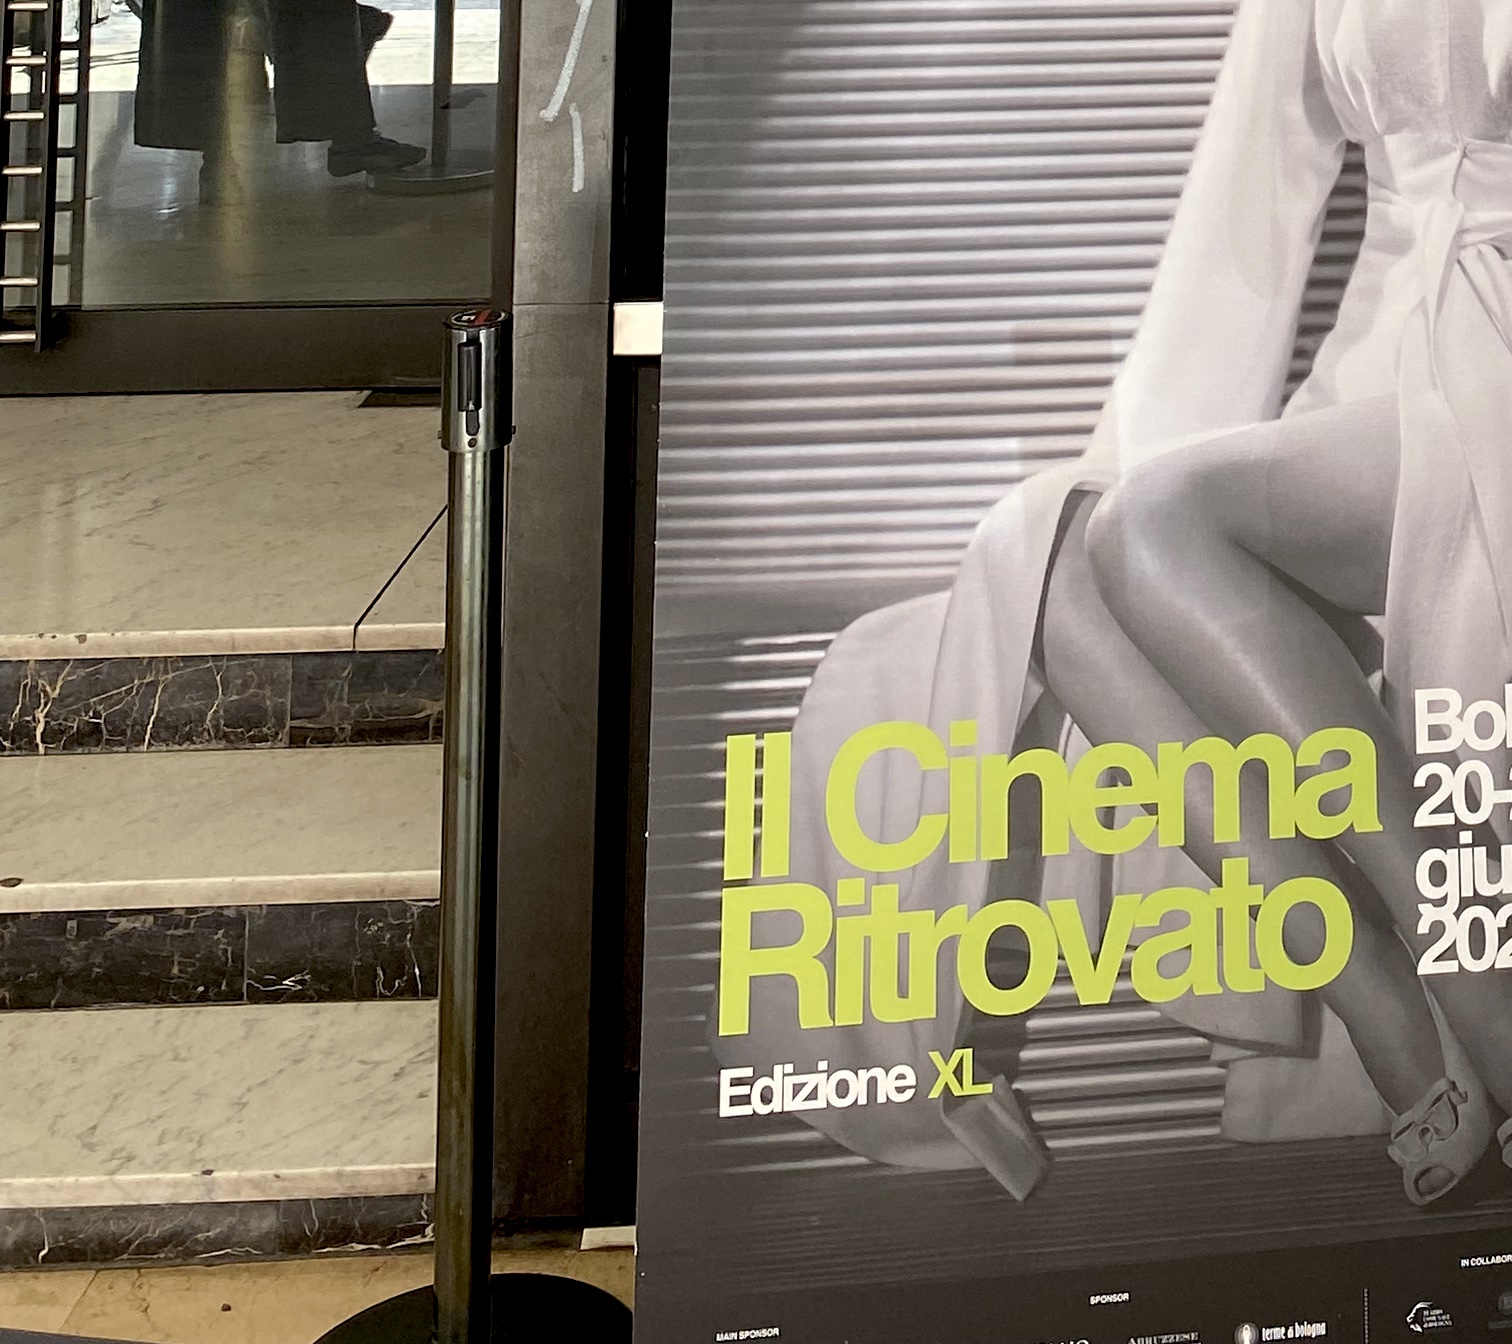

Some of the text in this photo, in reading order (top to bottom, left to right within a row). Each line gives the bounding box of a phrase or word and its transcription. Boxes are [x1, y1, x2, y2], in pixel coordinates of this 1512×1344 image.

[724, 719, 1383, 880] Il Cinema
[719, 857, 1354, 1035] Ritrovato
[718, 1049, 992, 1118] Edizione XL
[1460, 1259, 1469, 1267] IN
[1089, 1292, 1130, 1305] SPONSOR
[738, 1327, 780, 1340] SPONSOR
[1262, 1327, 1286, 1341] terme
[1294, 1321, 1326, 1337] bologna
